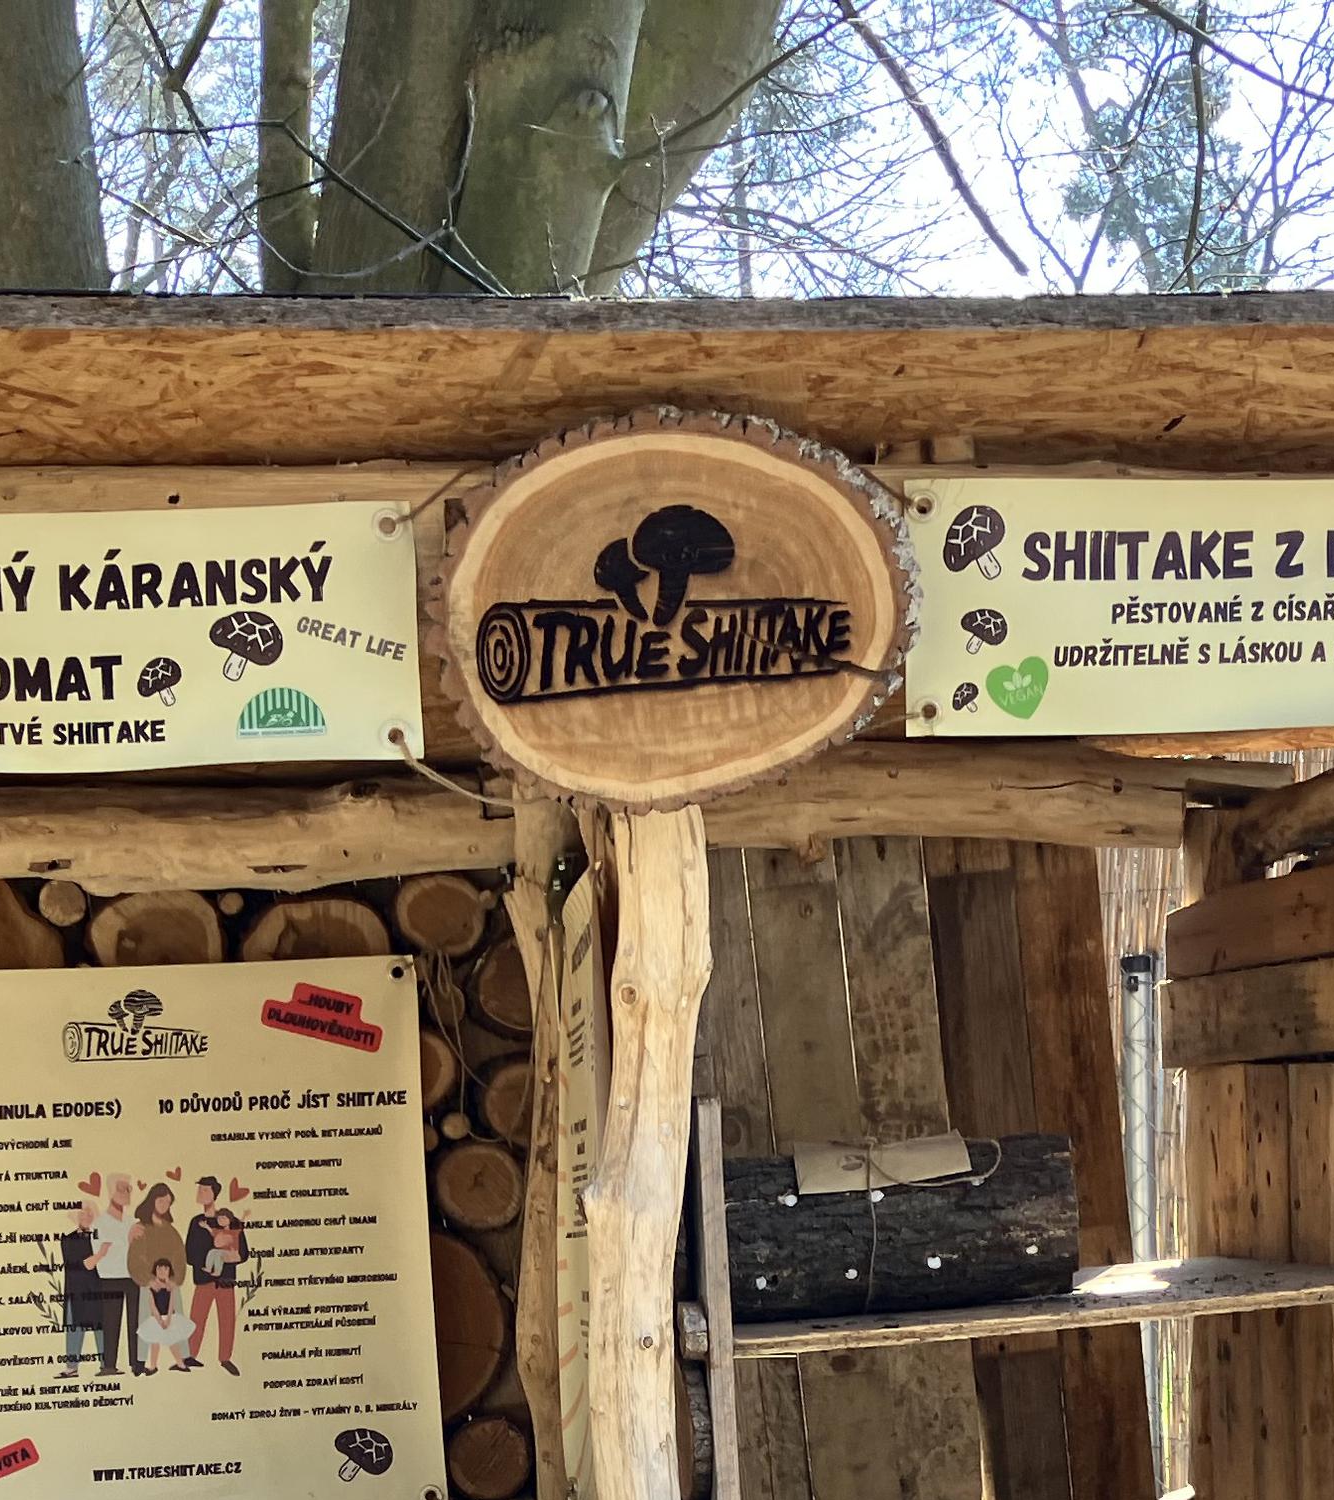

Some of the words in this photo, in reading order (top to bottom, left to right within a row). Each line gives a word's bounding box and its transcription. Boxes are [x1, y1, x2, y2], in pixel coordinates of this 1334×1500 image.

[1022, 528, 1254, 584] SHIITAKE
[1275, 528, 1306, 579] Z
[58, 540, 334, 611] KÁRANSKÝ
[1111, 597, 1242, 625] PĚSTOVANÉ
[1251, 600, 1265, 622] Z
[296, 615, 361, 648] GREAT
[364, 635, 408, 662] LIFE
[533, 610, 671, 691] TRUE
[678, 605, 851, 677] SHIITAKE
[1053, 639, 1189, 668] UDRŽITELNĚ
[1197, 645, 1211, 665] S
[1217, 638, 1303, 665] LÁSKOU
[1311, 643, 1327, 662] A
[998, 684, 1043, 706] VEGAN
[52, 719, 166, 745] SHIITAKE
[267, 1008, 375, 1047] DLOUHOVĚKOSTI
[85, 1028, 136, 1057] TRUE
[141, 1031, 208, 1058] SHIITAKE
[52, 1099, 122, 1118] EDODES)
[158, 1099, 174, 1114] 10
[180, 1091, 243, 1113] DŮVODŮ
[249, 1090, 291, 1111] PROČ
[298, 1089, 330, 1109] JÍST
[337, 1090, 407, 1108] SHIITAKE
[14, 1170, 68, 1181] STRUKTURA
[256, 1160, 305, 1170] PODPORUJE
[290, 1187, 349, 1198] CHOLESTEROL
[324, 1214, 346, 1226] CHUŤ
[22, 1385, 35, 1396] MÁ
[263, 1378, 304, 1389] PODPORA
[306, 1375, 338, 1387] ZDRAVÍ
[339, 1373, 364, 1385] KOSTÍ
[249, 1409, 276, 1419] ZDROJ
[93, 1461, 242, 1482] WWW.TRUESHIITAKE.CZ
